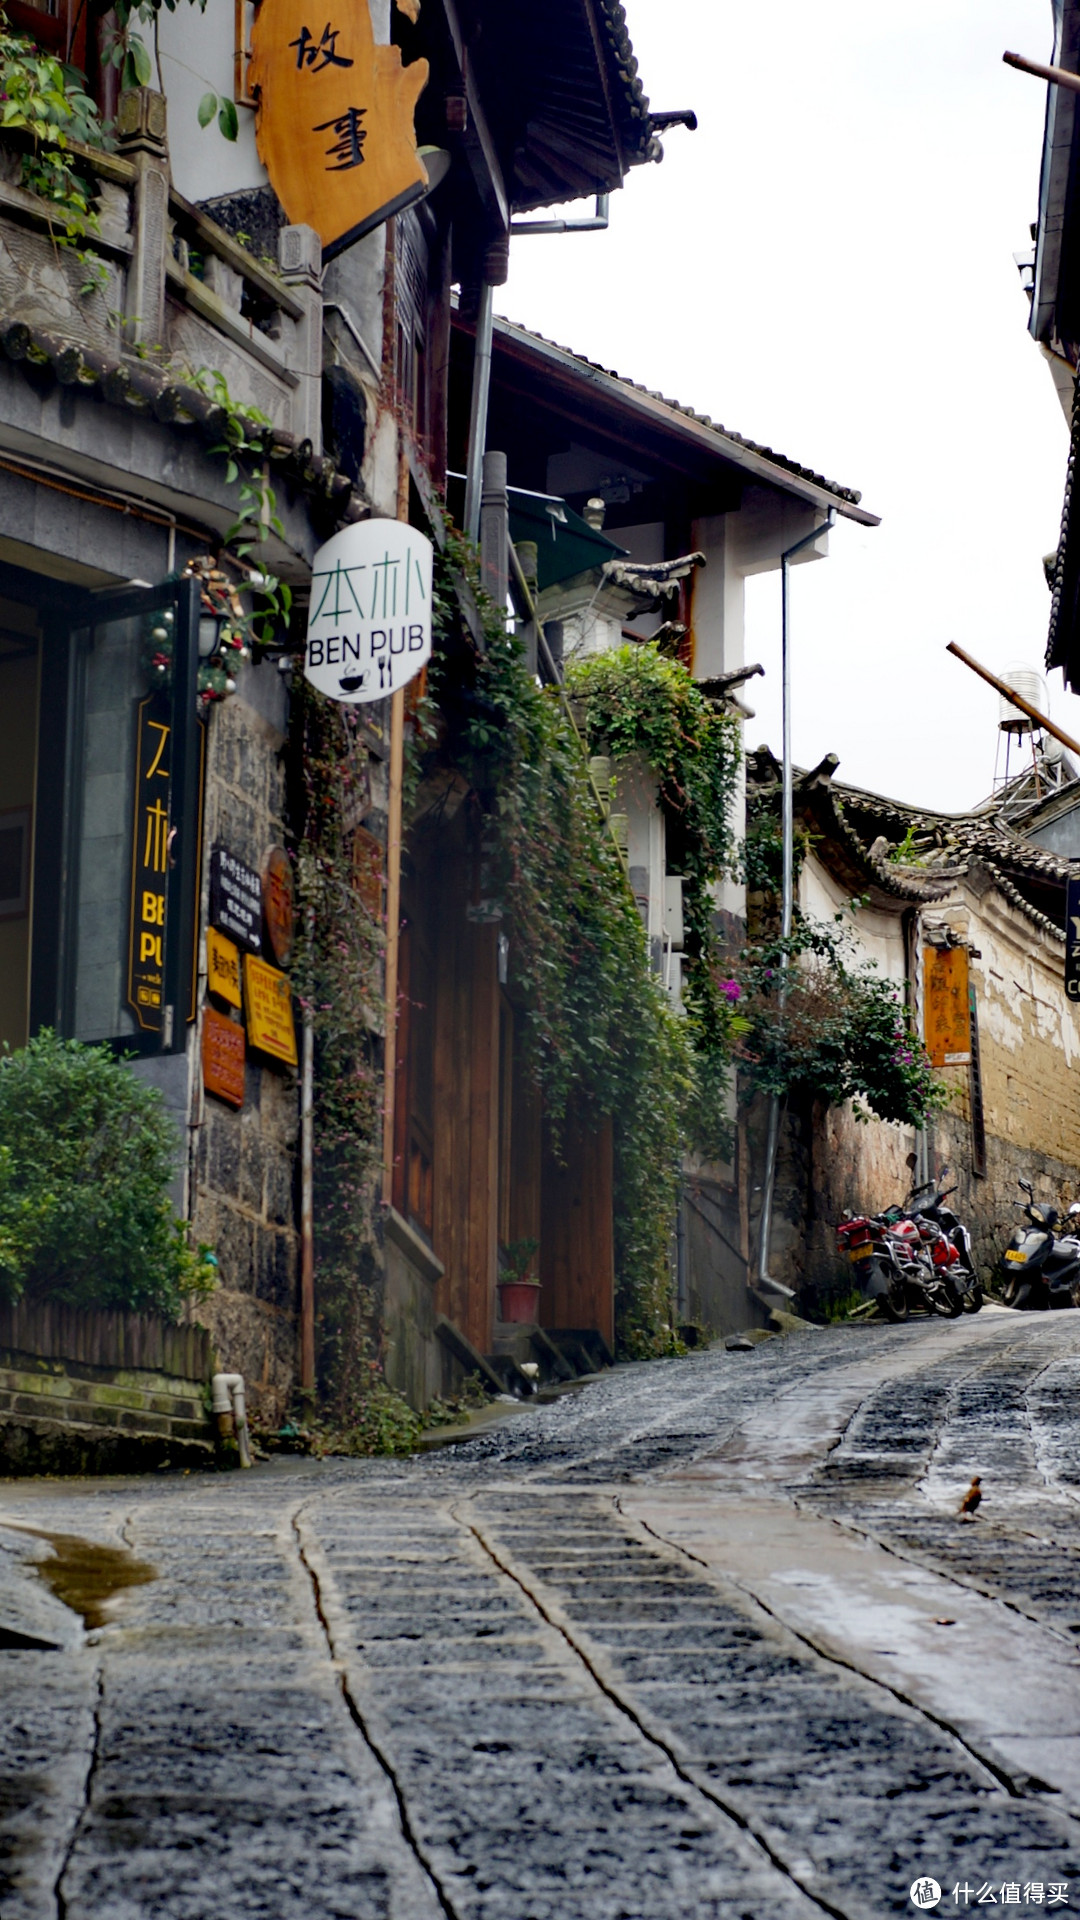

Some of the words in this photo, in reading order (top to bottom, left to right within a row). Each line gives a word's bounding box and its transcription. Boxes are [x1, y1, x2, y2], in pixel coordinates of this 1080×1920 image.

[288, 21, 368, 171] 故事
[308, 633, 361, 667] BEN
[370, 624, 424, 658] PUB
[141, 890, 165, 926] BE
